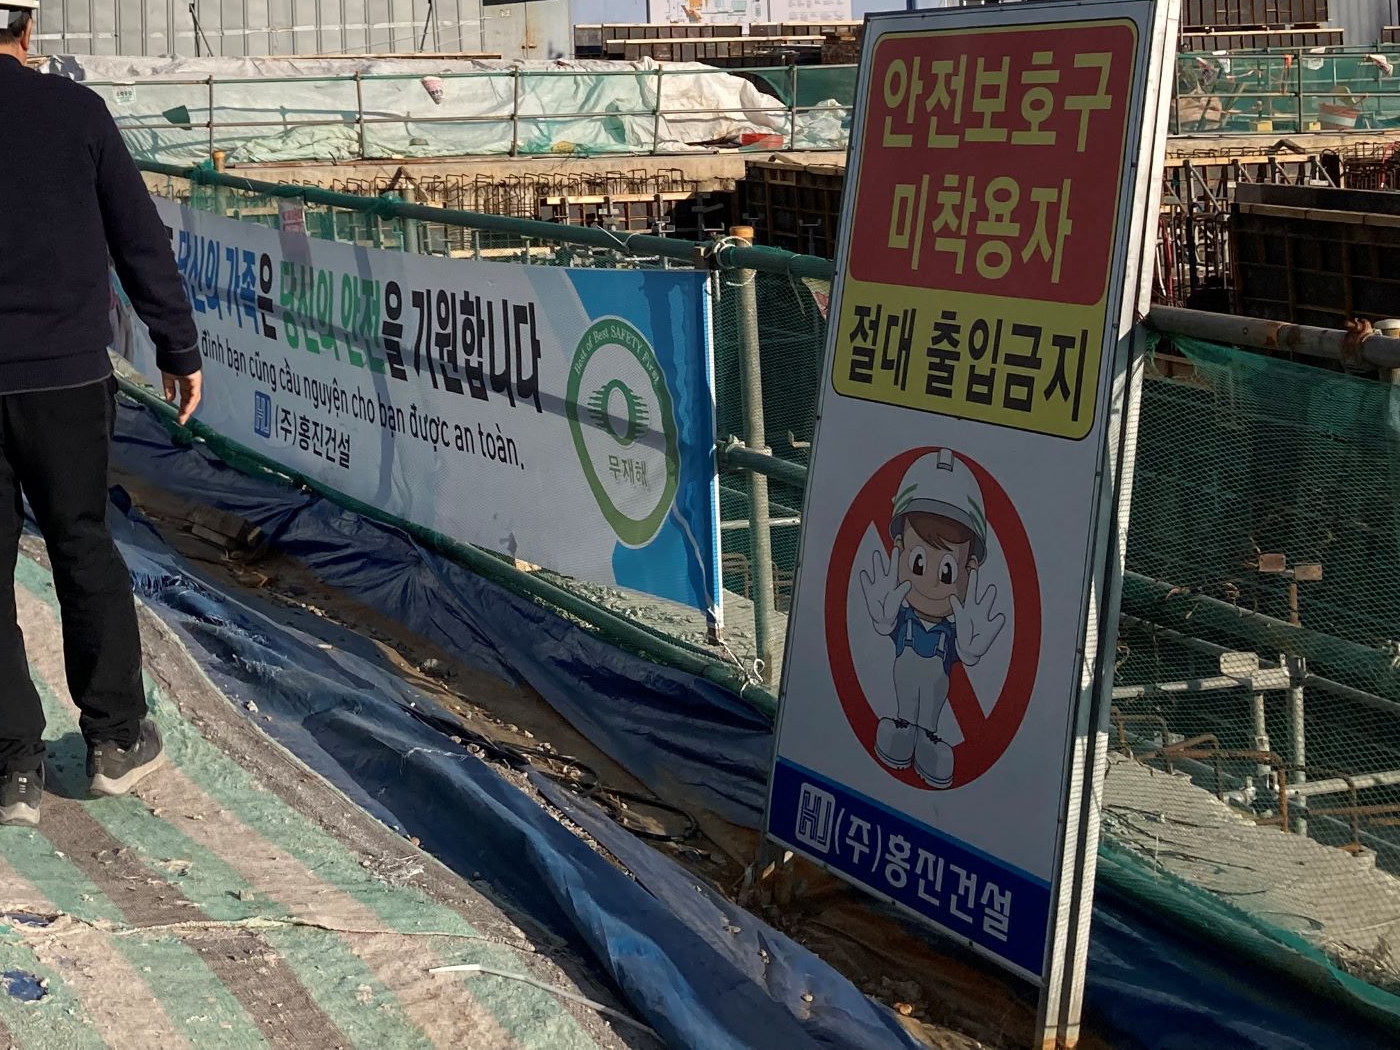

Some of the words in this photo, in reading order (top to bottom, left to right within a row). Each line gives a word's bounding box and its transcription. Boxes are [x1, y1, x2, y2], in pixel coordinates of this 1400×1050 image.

[881, 50, 1113, 153] 안전보호구
[887, 173, 1074, 285] 미착용자
[225, 245, 277, 341] 가족은
[279, 260, 340, 361] 당신의
[340, 272, 408, 382] 안전을
[411, 288, 543, 414] 기원합니다
[610, 325, 643, 354] SAFETY
[848, 303, 918, 392] 절대
[924, 310, 1090, 423] 출입금지
[201, 330, 225, 359] đình
[227, 340, 246, 377] bạn
[249, 351, 277, 392] cũng
[279, 358, 301, 397] cầu
[303, 377, 349, 417] nguyện
[352, 386, 376, 424] cho
[377, 393, 406, 439] bạn
[410, 403, 451, 452] được
[455, 423, 475, 455] an
[478, 423, 525, 470] toàn.
[275, 404, 350, 470] (주)홍진건설
[608, 454, 649, 488] 무재해
[834, 807, 1013, 943] (주)홍진건설
